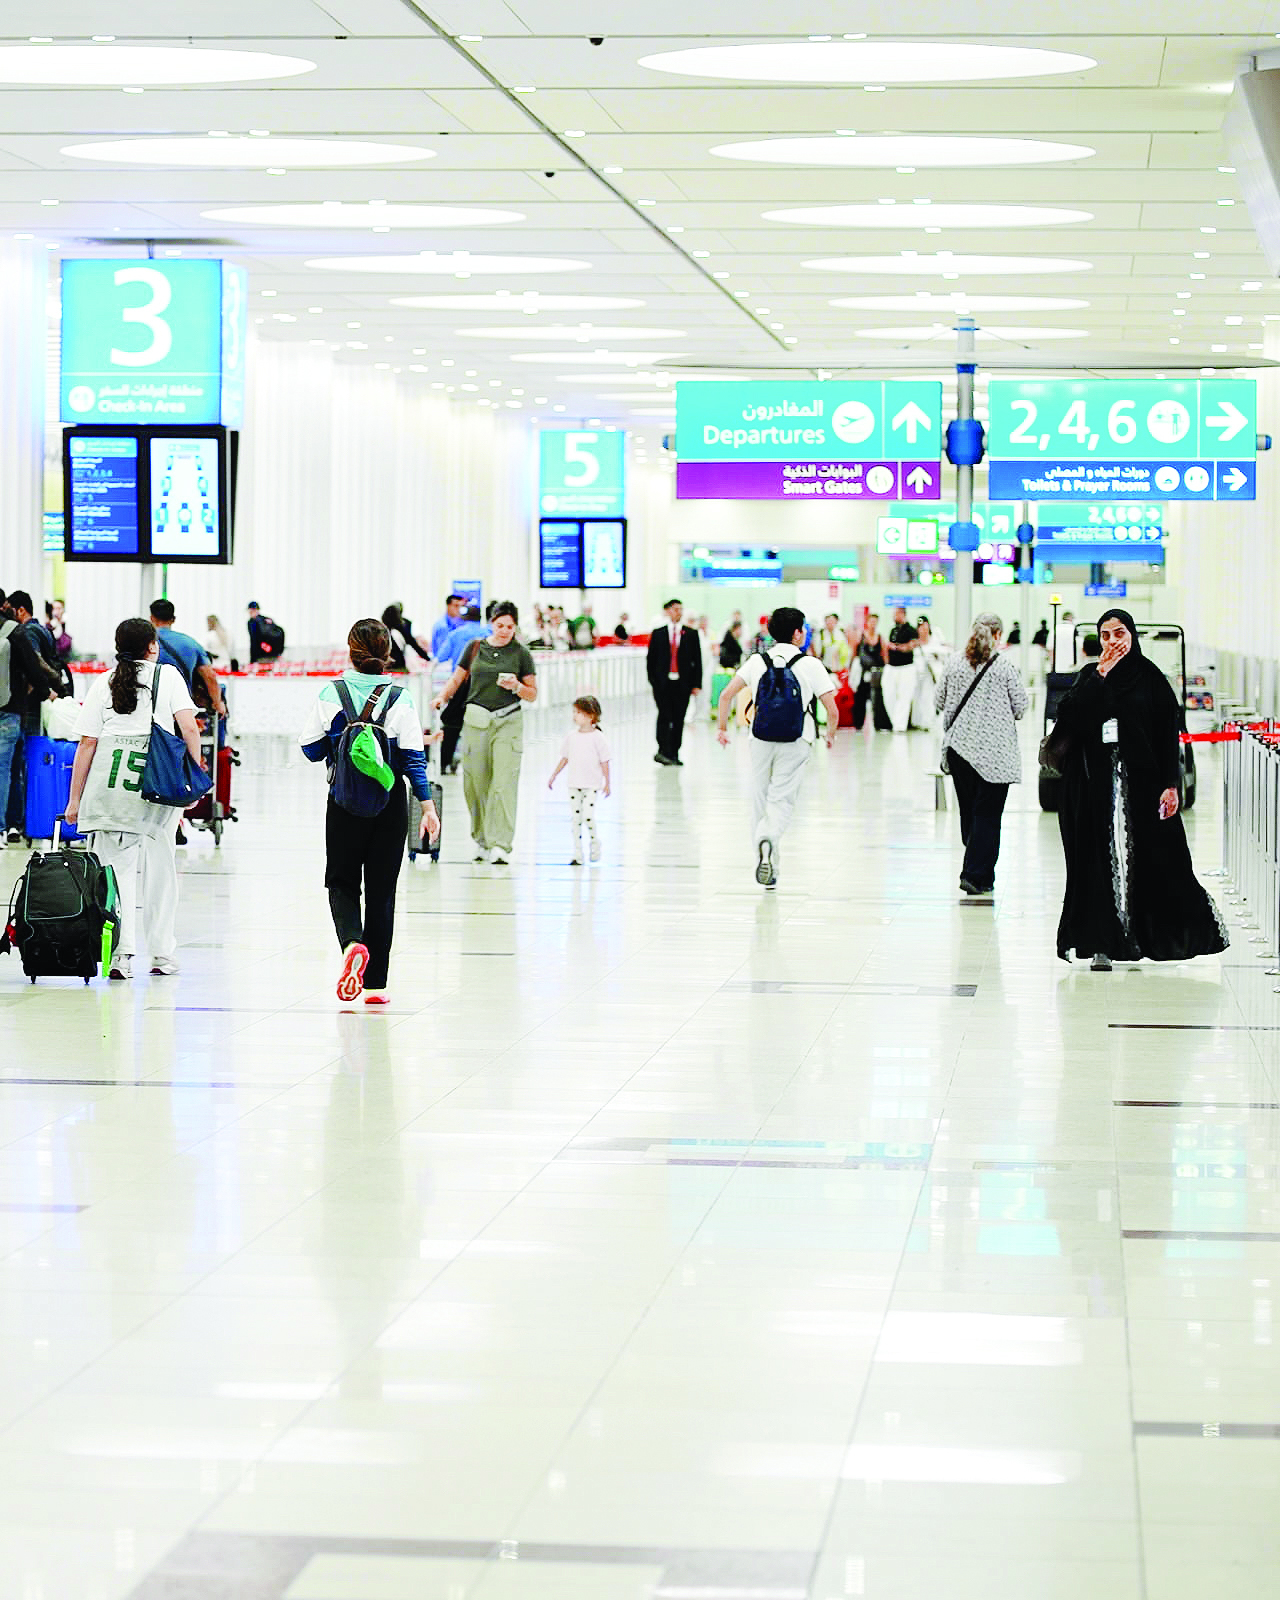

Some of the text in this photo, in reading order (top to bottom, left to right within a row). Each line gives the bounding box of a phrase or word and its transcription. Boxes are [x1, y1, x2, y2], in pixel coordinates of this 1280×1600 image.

[110, 267, 172, 368] 3
[154, 399, 186, 413] Area
[742, 399, 824, 422] المغادرون
[703, 425, 826, 449] Departures
[564, 432, 600, 487] 5
[783, 480, 863, 494] Smart Gates
[1021, 479, 1151, 494] Toilets & Prayer Rooms
[108, 749, 147, 792] 15
